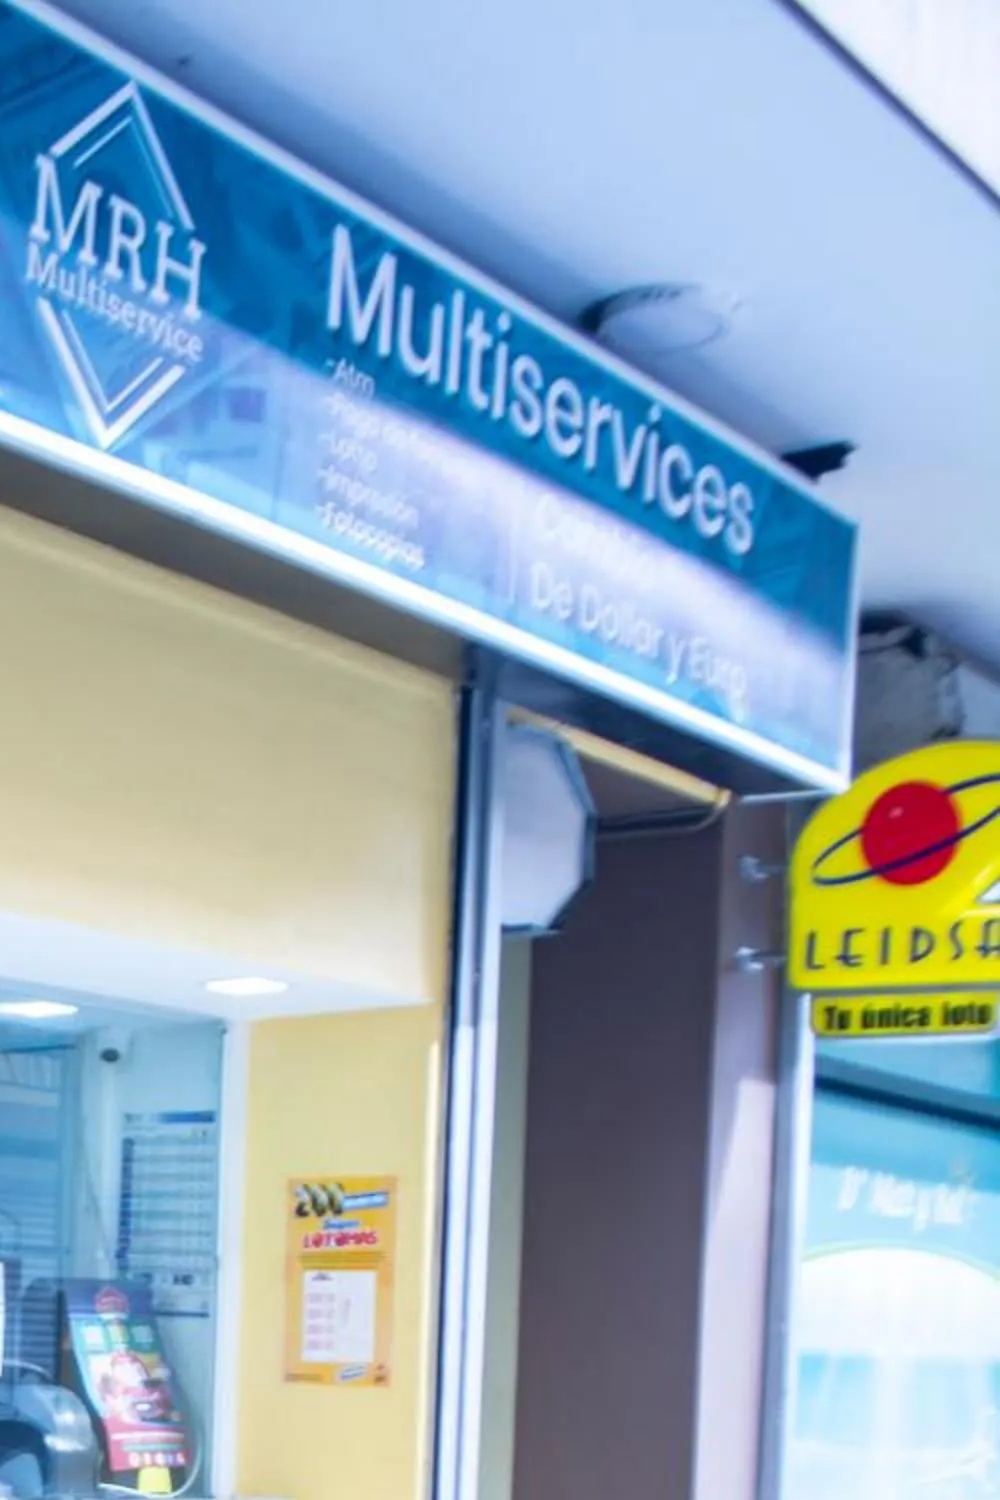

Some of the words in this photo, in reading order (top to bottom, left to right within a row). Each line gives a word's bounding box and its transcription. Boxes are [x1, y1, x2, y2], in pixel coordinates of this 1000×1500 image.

[30, 153, 206, 321] MRH
[25, 240, 204, 361] Multiservice
[327, 222, 755, 556] Multiservices
[531, 560, 574, 620] De
[806, 918, 1000, 970] LEIDSA
[823, 1004, 851, 1031] Tu
